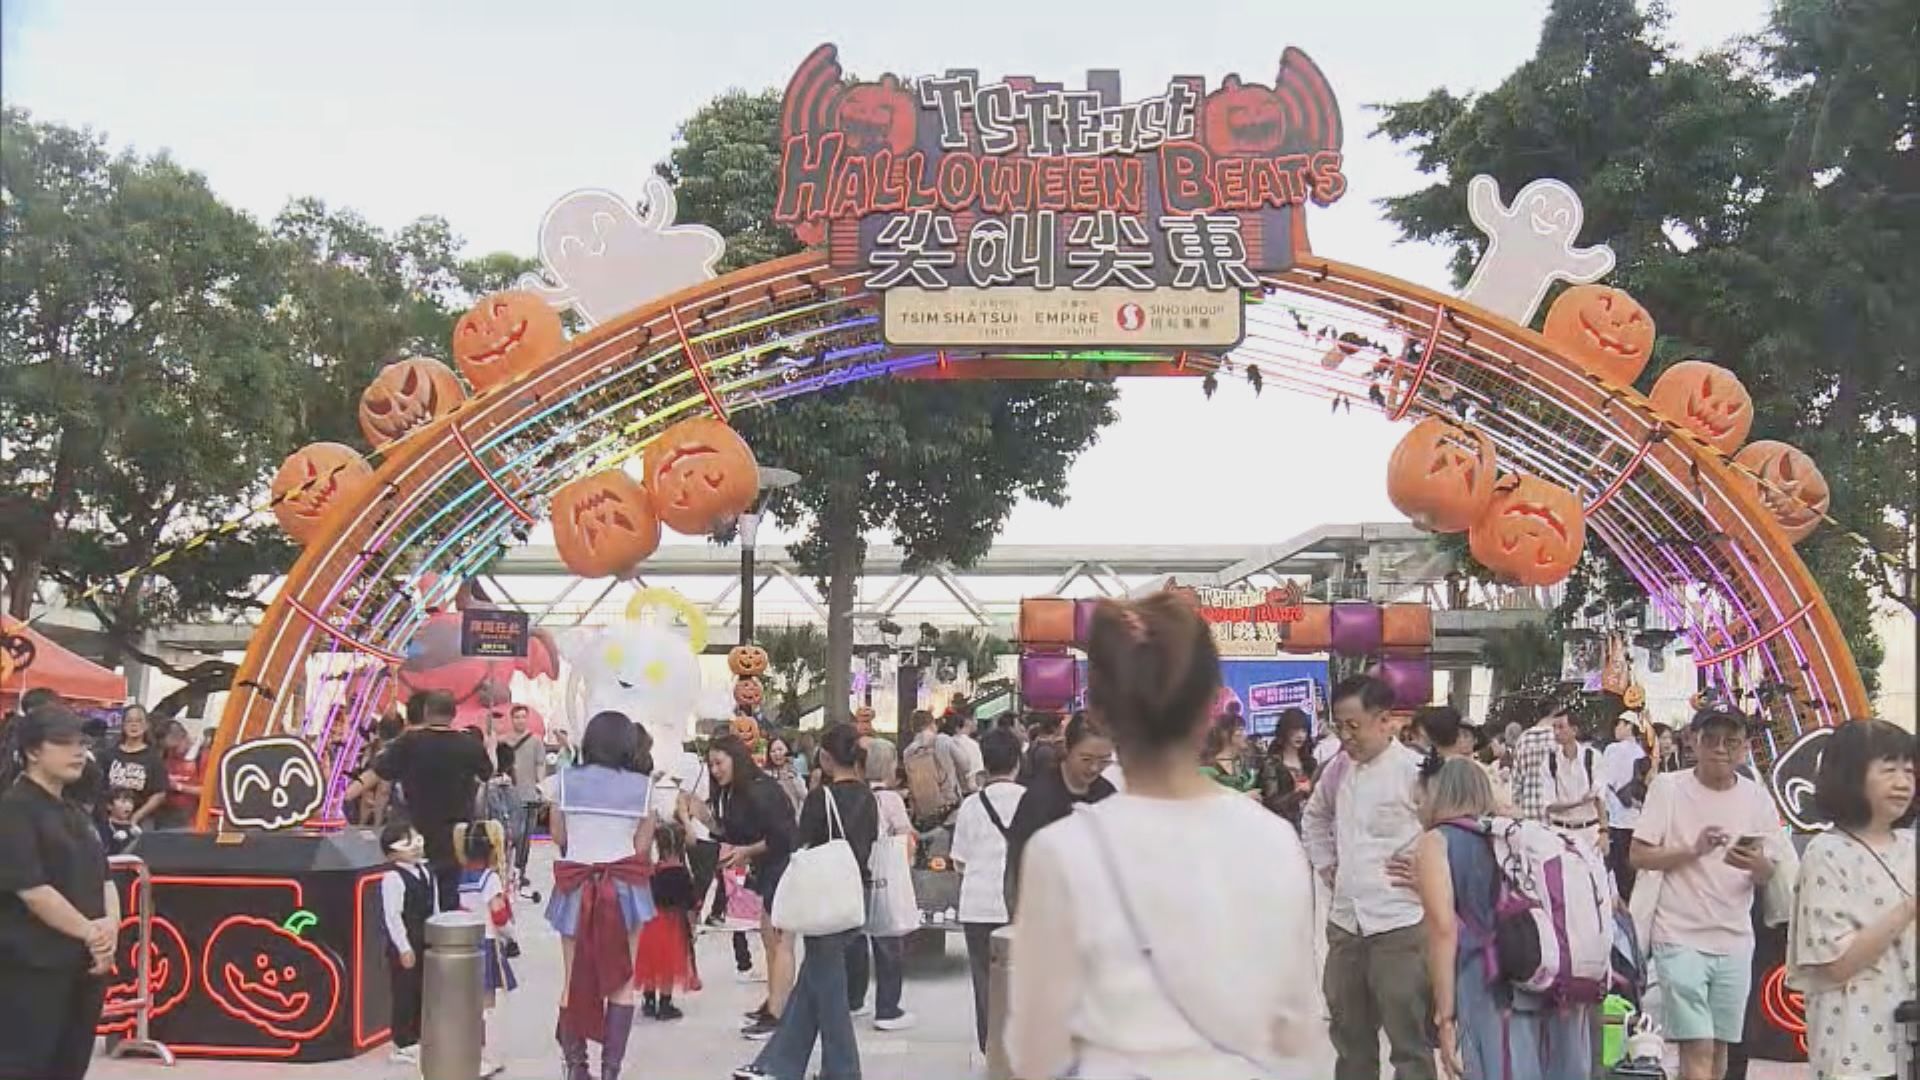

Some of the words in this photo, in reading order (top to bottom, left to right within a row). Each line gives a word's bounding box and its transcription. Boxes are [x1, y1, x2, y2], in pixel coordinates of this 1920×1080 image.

[774, 131, 1142, 221] HALLOWEEN
[1160, 140, 1347, 215] BEATS
[900, 310, 939, 325] TSIM
[943, 310, 977, 325] SHA
[980, 310, 1019, 325] TSUI
[1034, 311, 1100, 325] EMPIRE
